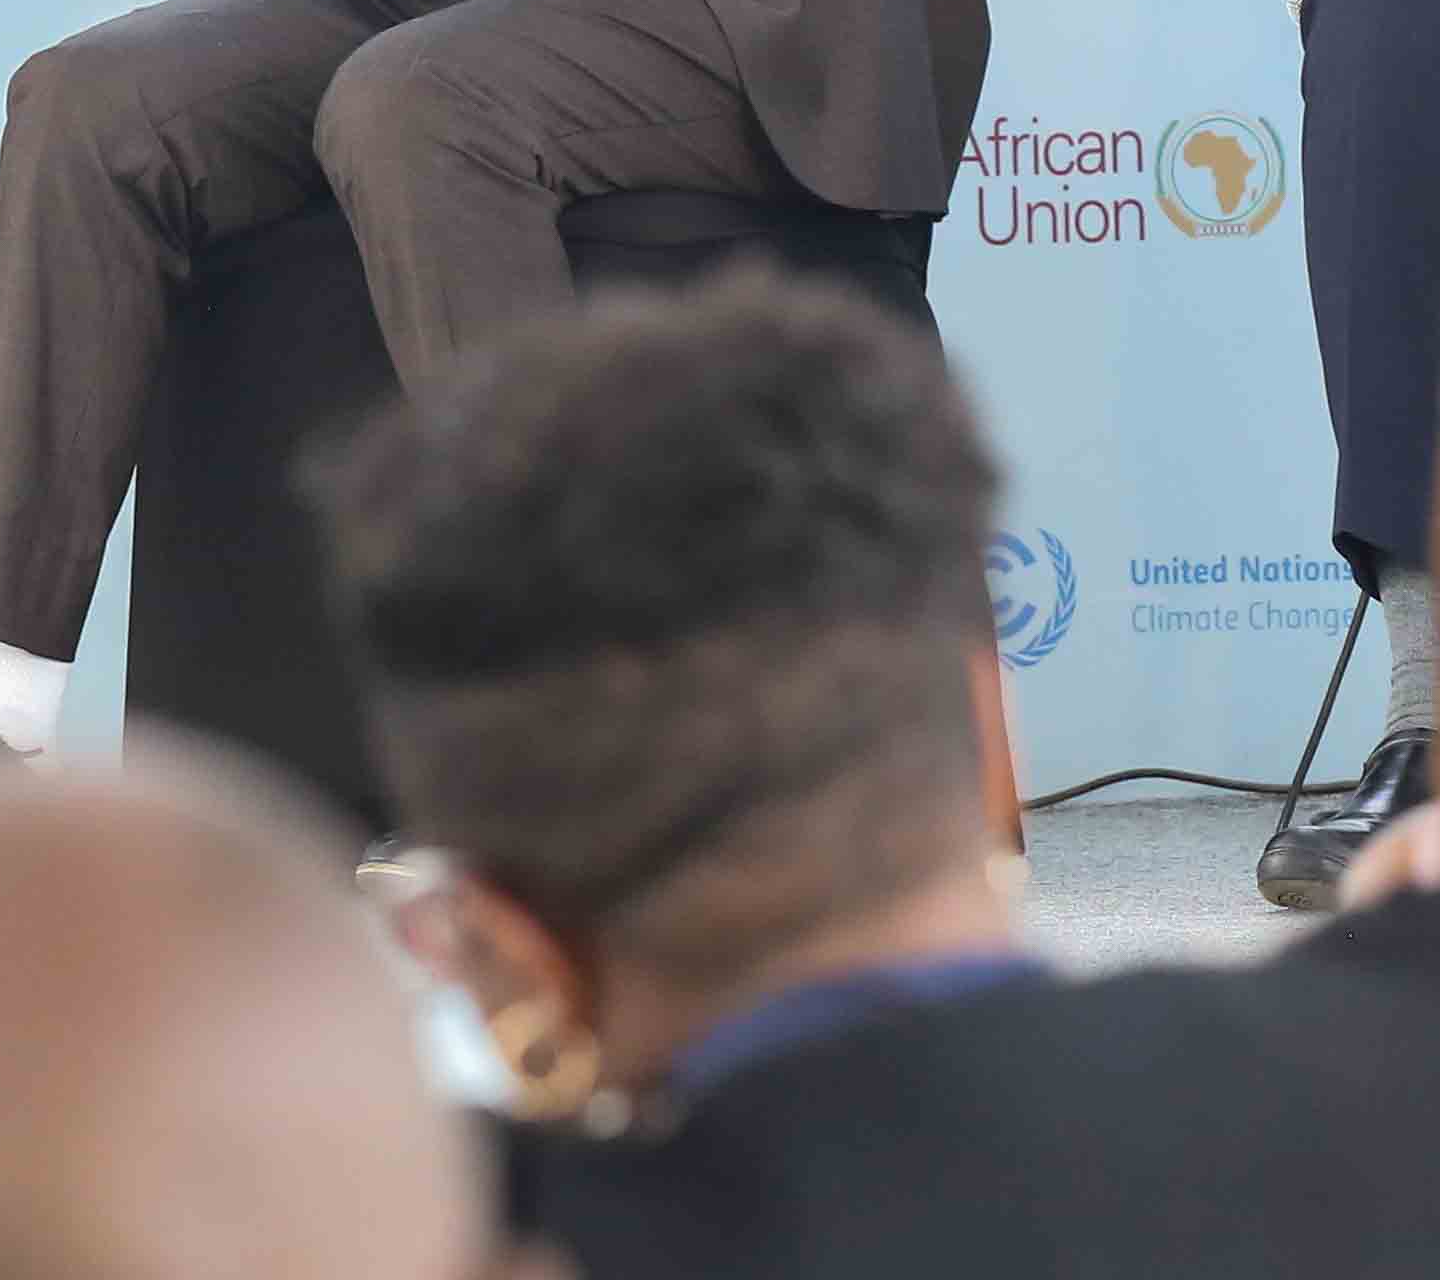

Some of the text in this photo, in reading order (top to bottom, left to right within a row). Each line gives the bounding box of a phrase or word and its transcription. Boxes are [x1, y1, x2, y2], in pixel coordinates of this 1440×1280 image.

[977, 184, 1146, 245] Union
[1130, 554, 1354, 587] United Nations
[1130, 603, 1238, 633] Climate
